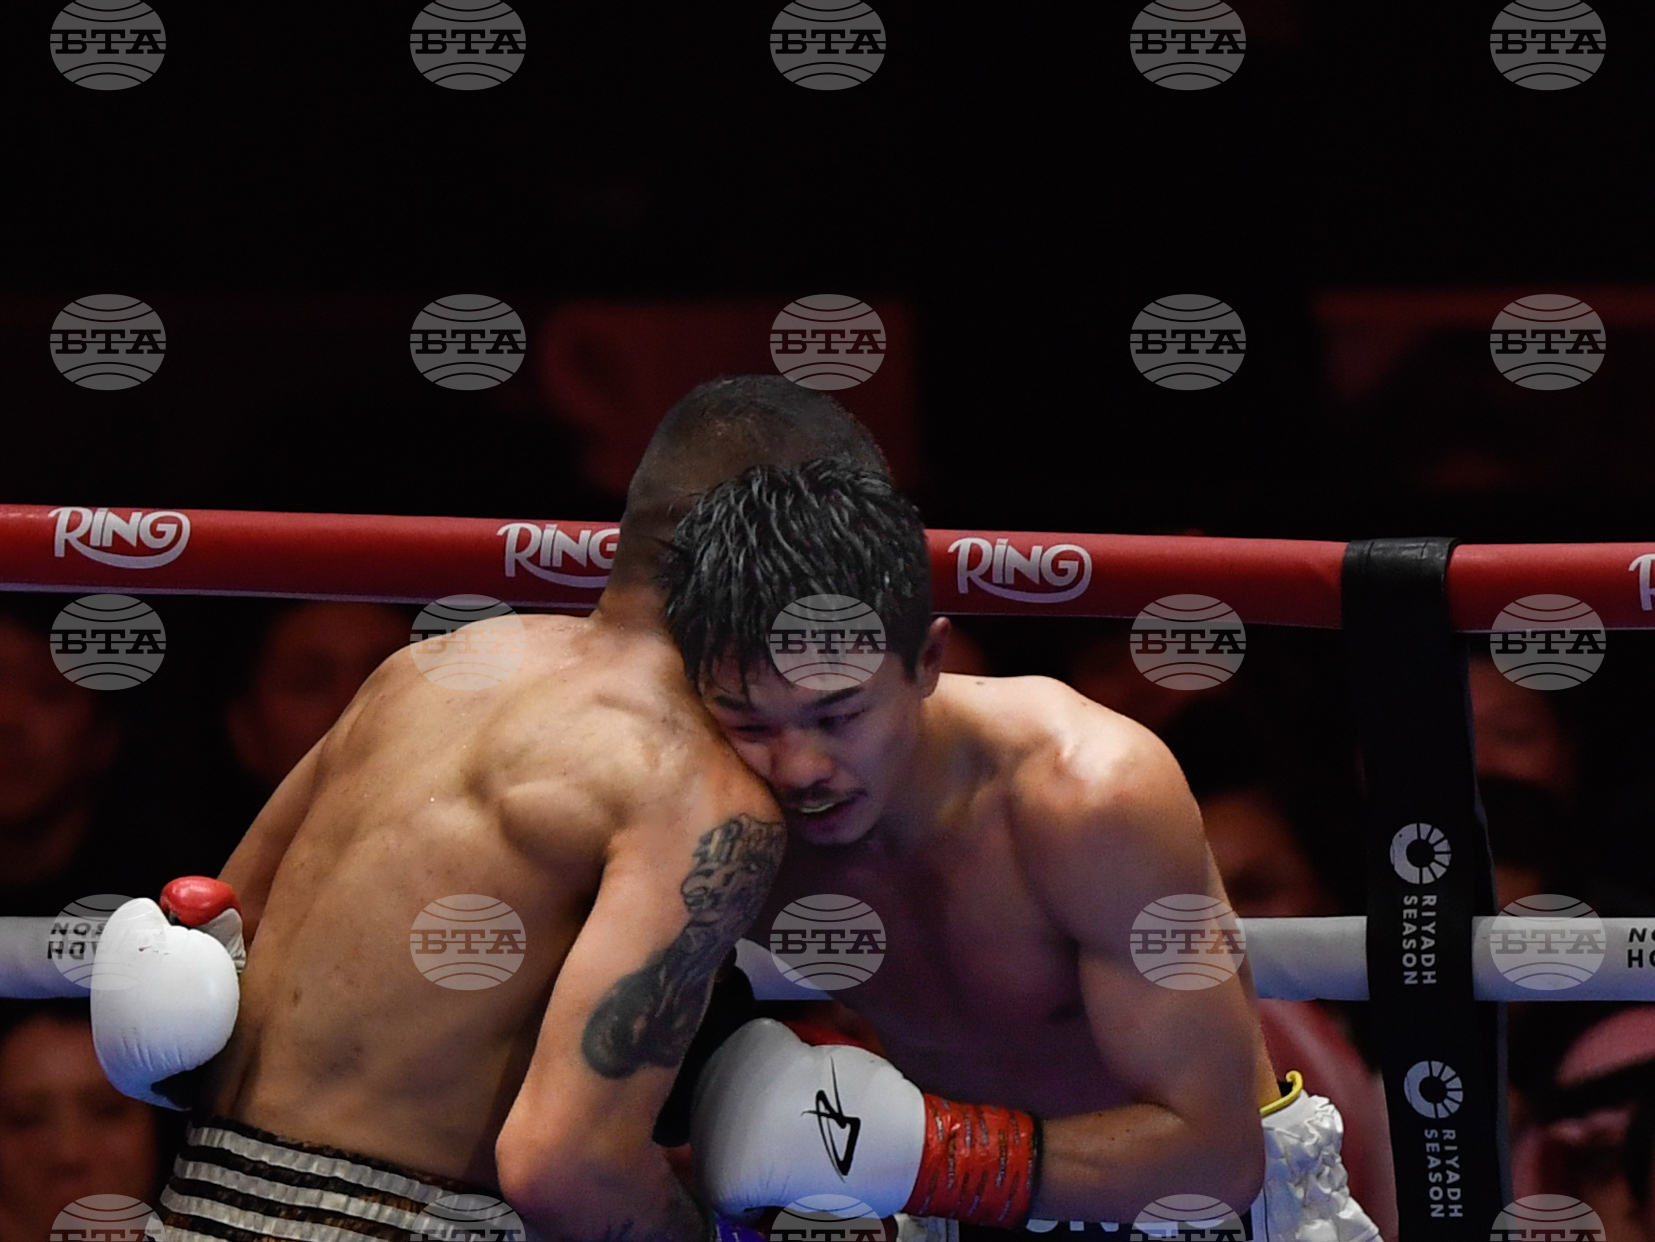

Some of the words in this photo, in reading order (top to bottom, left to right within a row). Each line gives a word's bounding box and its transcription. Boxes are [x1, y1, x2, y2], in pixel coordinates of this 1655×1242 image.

[48, 506, 191, 569] RING
[947, 537, 1093, 603] RING
[1402, 895, 1419, 985] SEASON
[1420, 894, 1437, 985] RIYADH
[1424, 1129, 1446, 1218] SEASON
[1442, 1129, 1463, 1218] RIYADH
